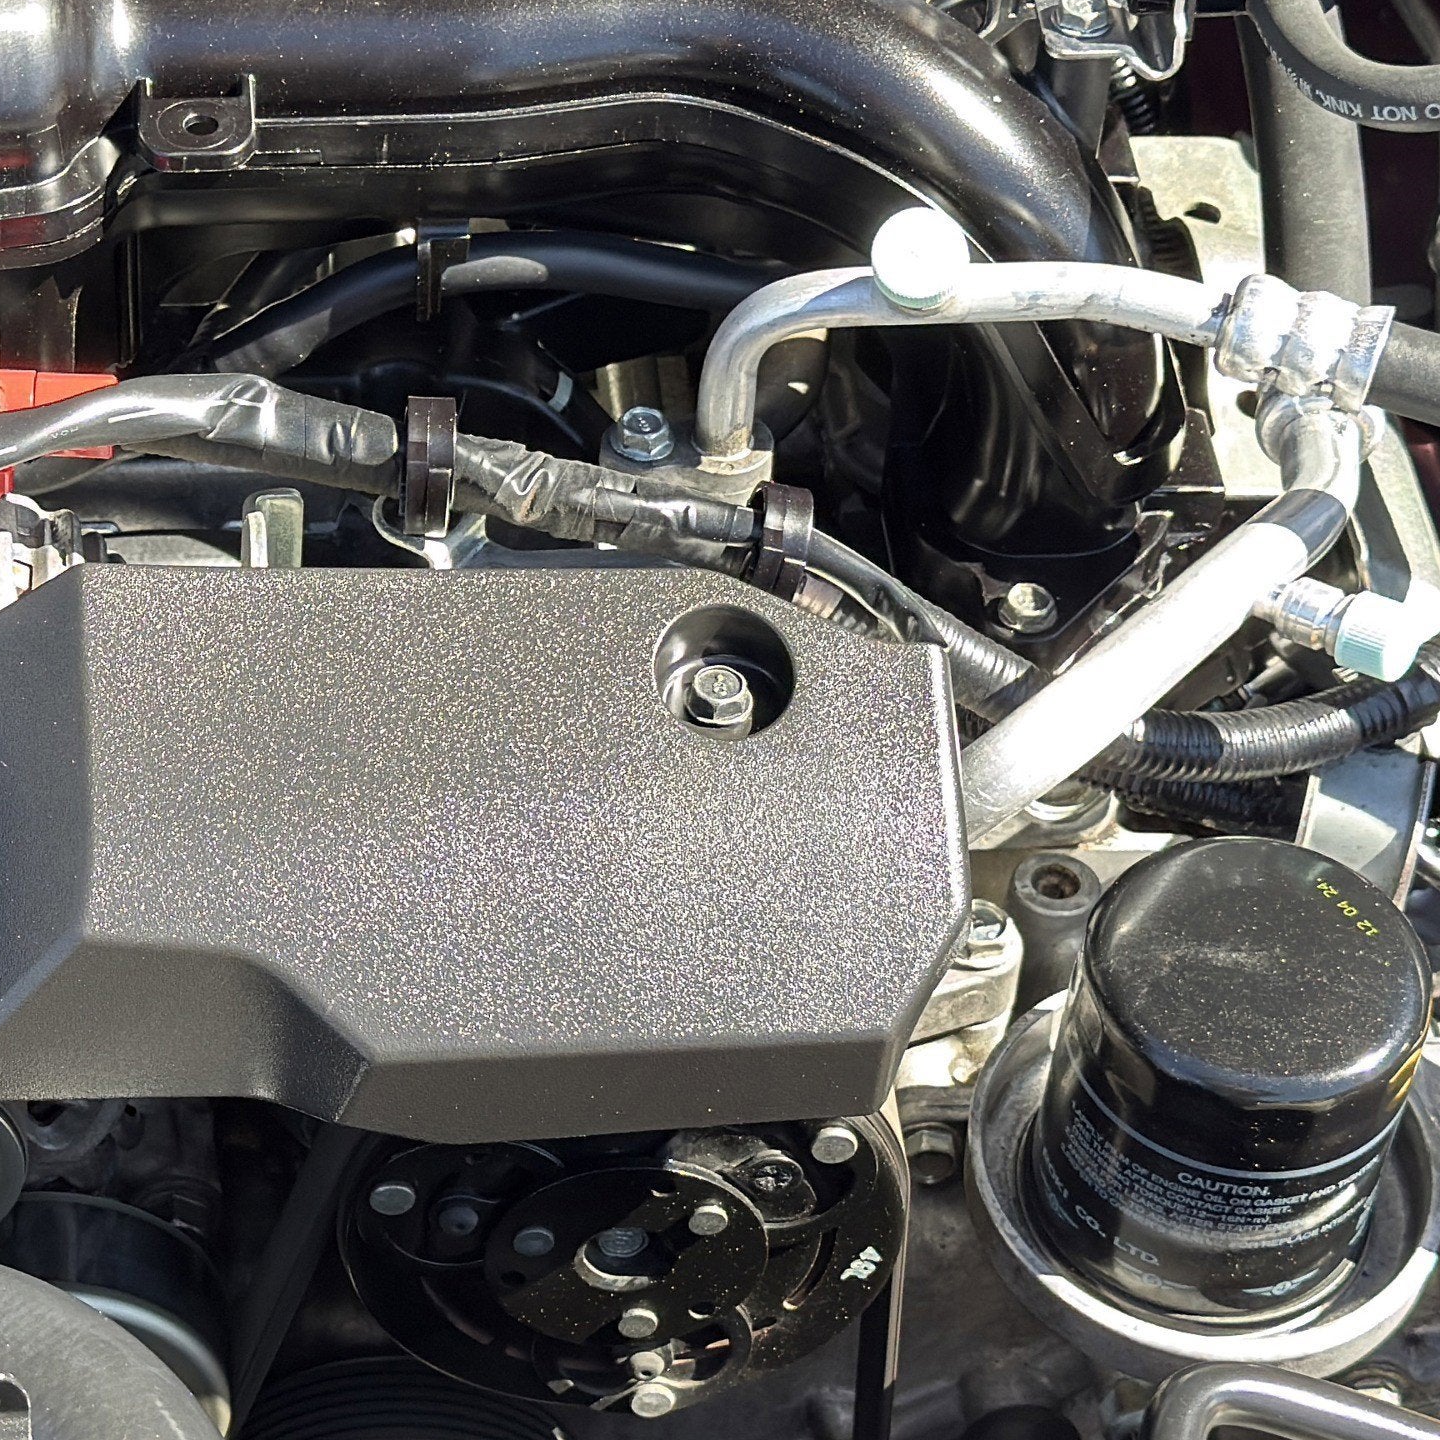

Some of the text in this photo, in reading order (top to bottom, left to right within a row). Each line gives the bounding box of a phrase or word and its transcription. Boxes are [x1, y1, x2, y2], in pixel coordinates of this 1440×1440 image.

[1369, 103, 1416, 120] NOT
[1335, 896, 1359, 920] 04
[1355, 915, 1380, 941] 12
[1178, 1171, 1271, 1196] CAUTION.
